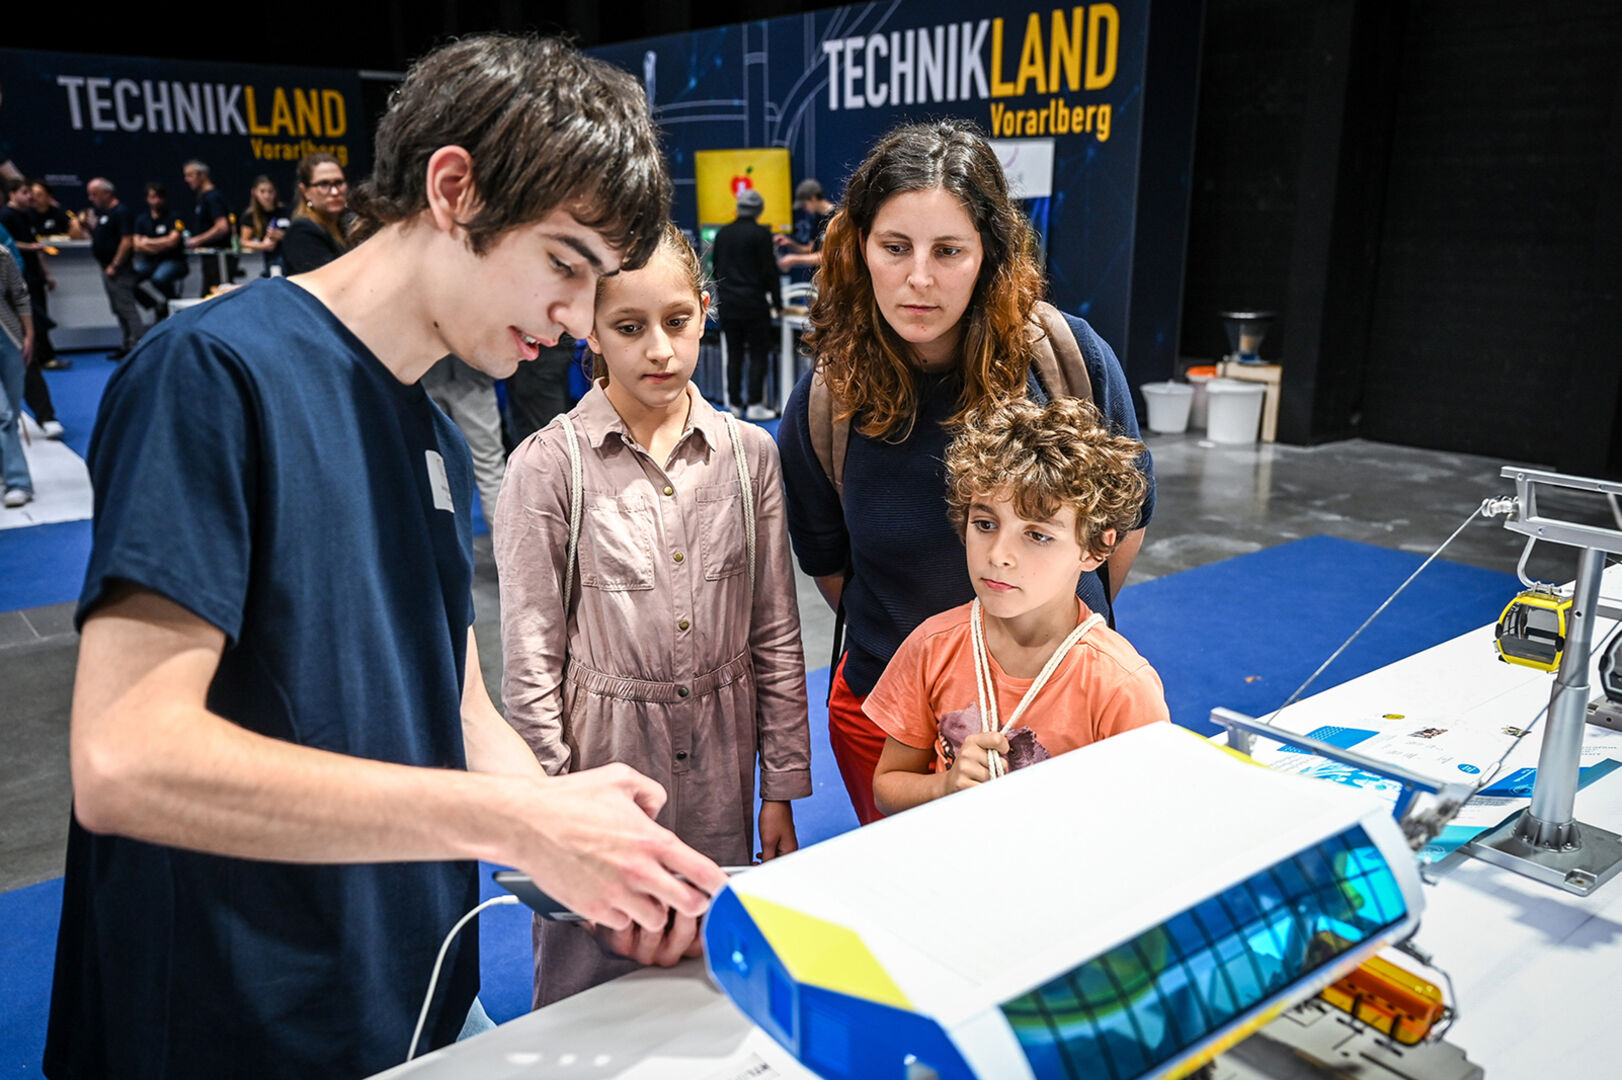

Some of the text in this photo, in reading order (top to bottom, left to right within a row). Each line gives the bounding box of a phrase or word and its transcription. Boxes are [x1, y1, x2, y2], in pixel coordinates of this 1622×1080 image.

[823, 4, 1119, 110] TECHNIKLAND
[57, 76, 346, 136] TECHNIKLAND
[990, 99, 1111, 141] Vorarlberg
